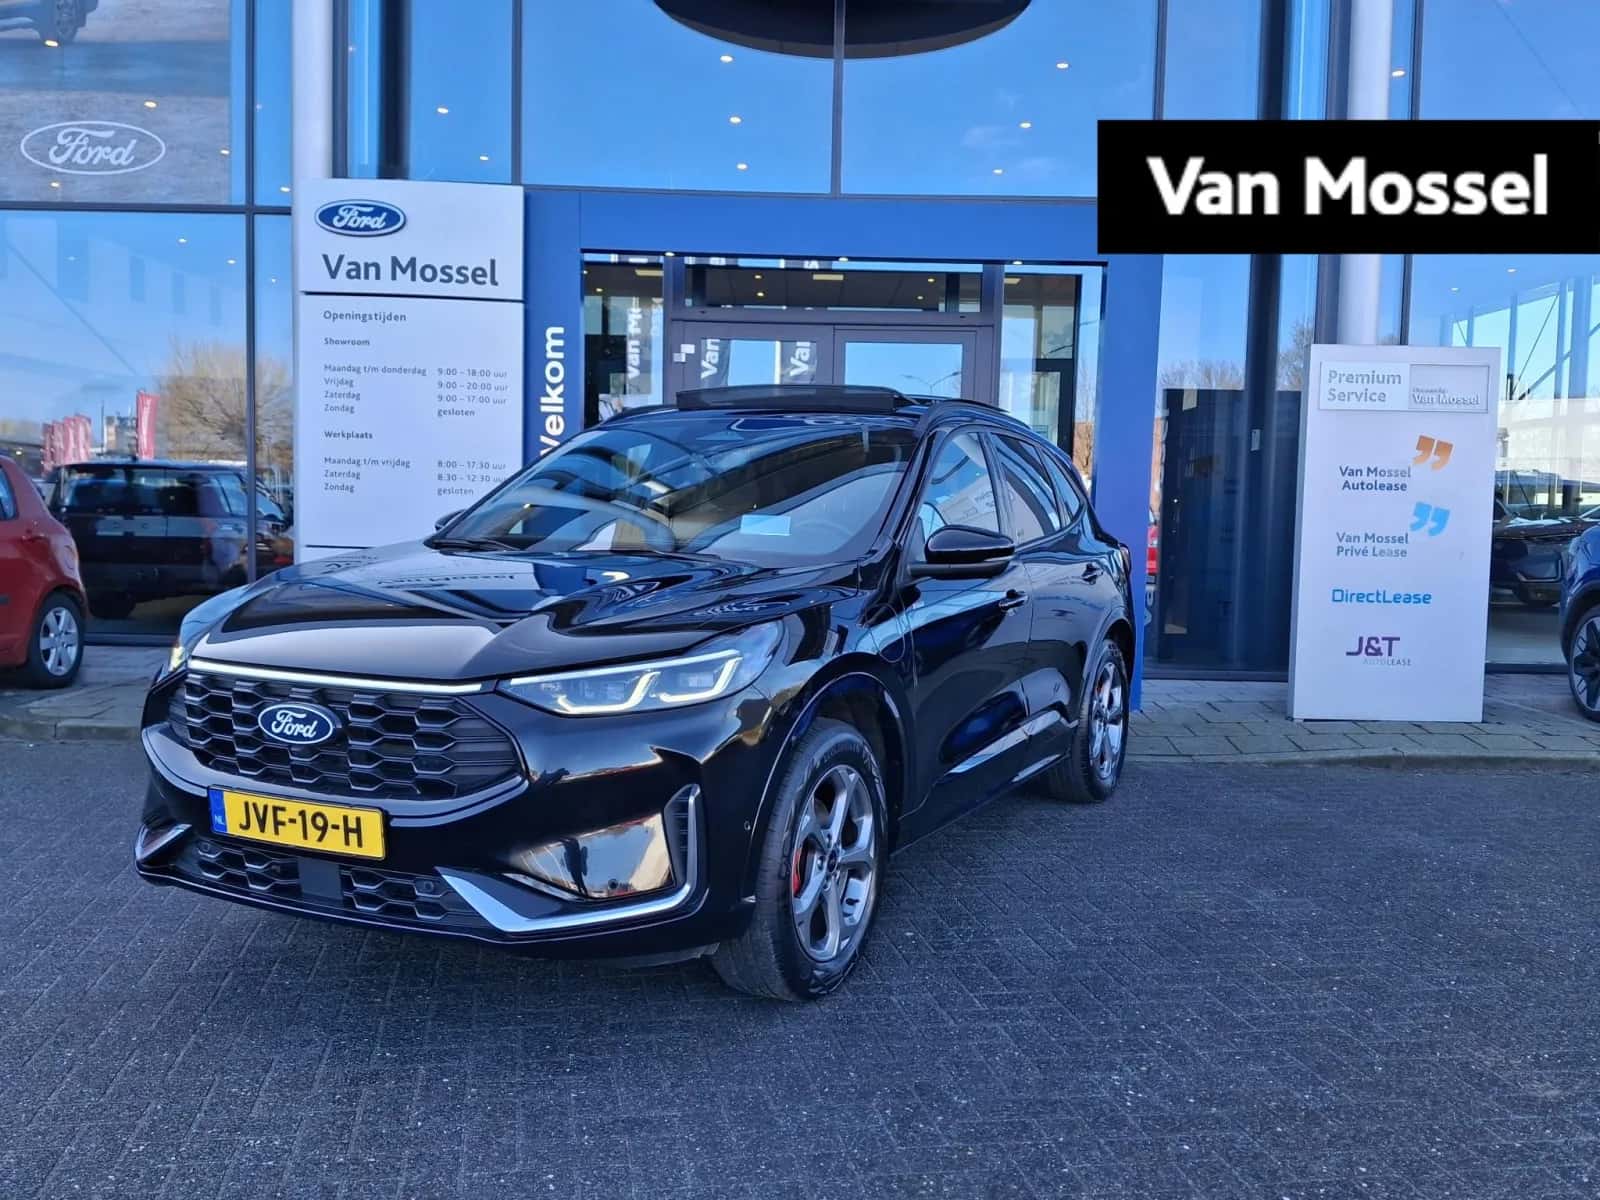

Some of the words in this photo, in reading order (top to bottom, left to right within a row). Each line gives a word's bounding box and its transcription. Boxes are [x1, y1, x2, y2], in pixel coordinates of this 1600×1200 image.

[49, 128, 137, 166] Ford
[332, 204, 387, 230] Ford
[322, 253, 382, 281] Van
[390, 255, 499, 287] Mossel
[323, 310, 407, 324] Openingstijden
[323, 337, 370, 347] Showroom
[700, 339, 721, 379] Van
[323, 364, 361, 375] Maandag
[363, 365, 379, 374] t/m
[381, 366, 427, 377] donderdag
[323, 378, 354, 388] Vrijdag
[1327, 370, 1402, 385] Premium
[323, 390, 361, 401] Zaterdag
[1327, 388, 1387, 402] Service
[323, 403, 355, 414] Zondag
[437, 408, 475, 418] gesloten
[323, 431, 373, 440] Werkplaats
[323, 457, 361, 467] Maandag
[363, 458, 379, 466] t/m
[381, 458, 411, 469] vrijdag
[323, 470, 361, 480] Zaterdag
[1339, 465, 1363, 478] Van
[1366, 465, 1412, 478] Mossel
[323, 483, 354, 493] Zondag
[437, 487, 474, 496] gesloten
[1341, 480, 1408, 492] Autolease
[1336, 532, 1361, 543] Van
[1364, 533, 1409, 545] Mossel
[1336, 545, 1369, 557] Privé
[1372, 547, 1408, 558] Lease
[1331, 589, 1432, 604] DirectLease
[1345, 636, 1401, 657] J&T
[271, 709, 318, 738] Ford
[214, 815, 225, 825] NL
[238, 801, 364, 849] JVF-19-H
